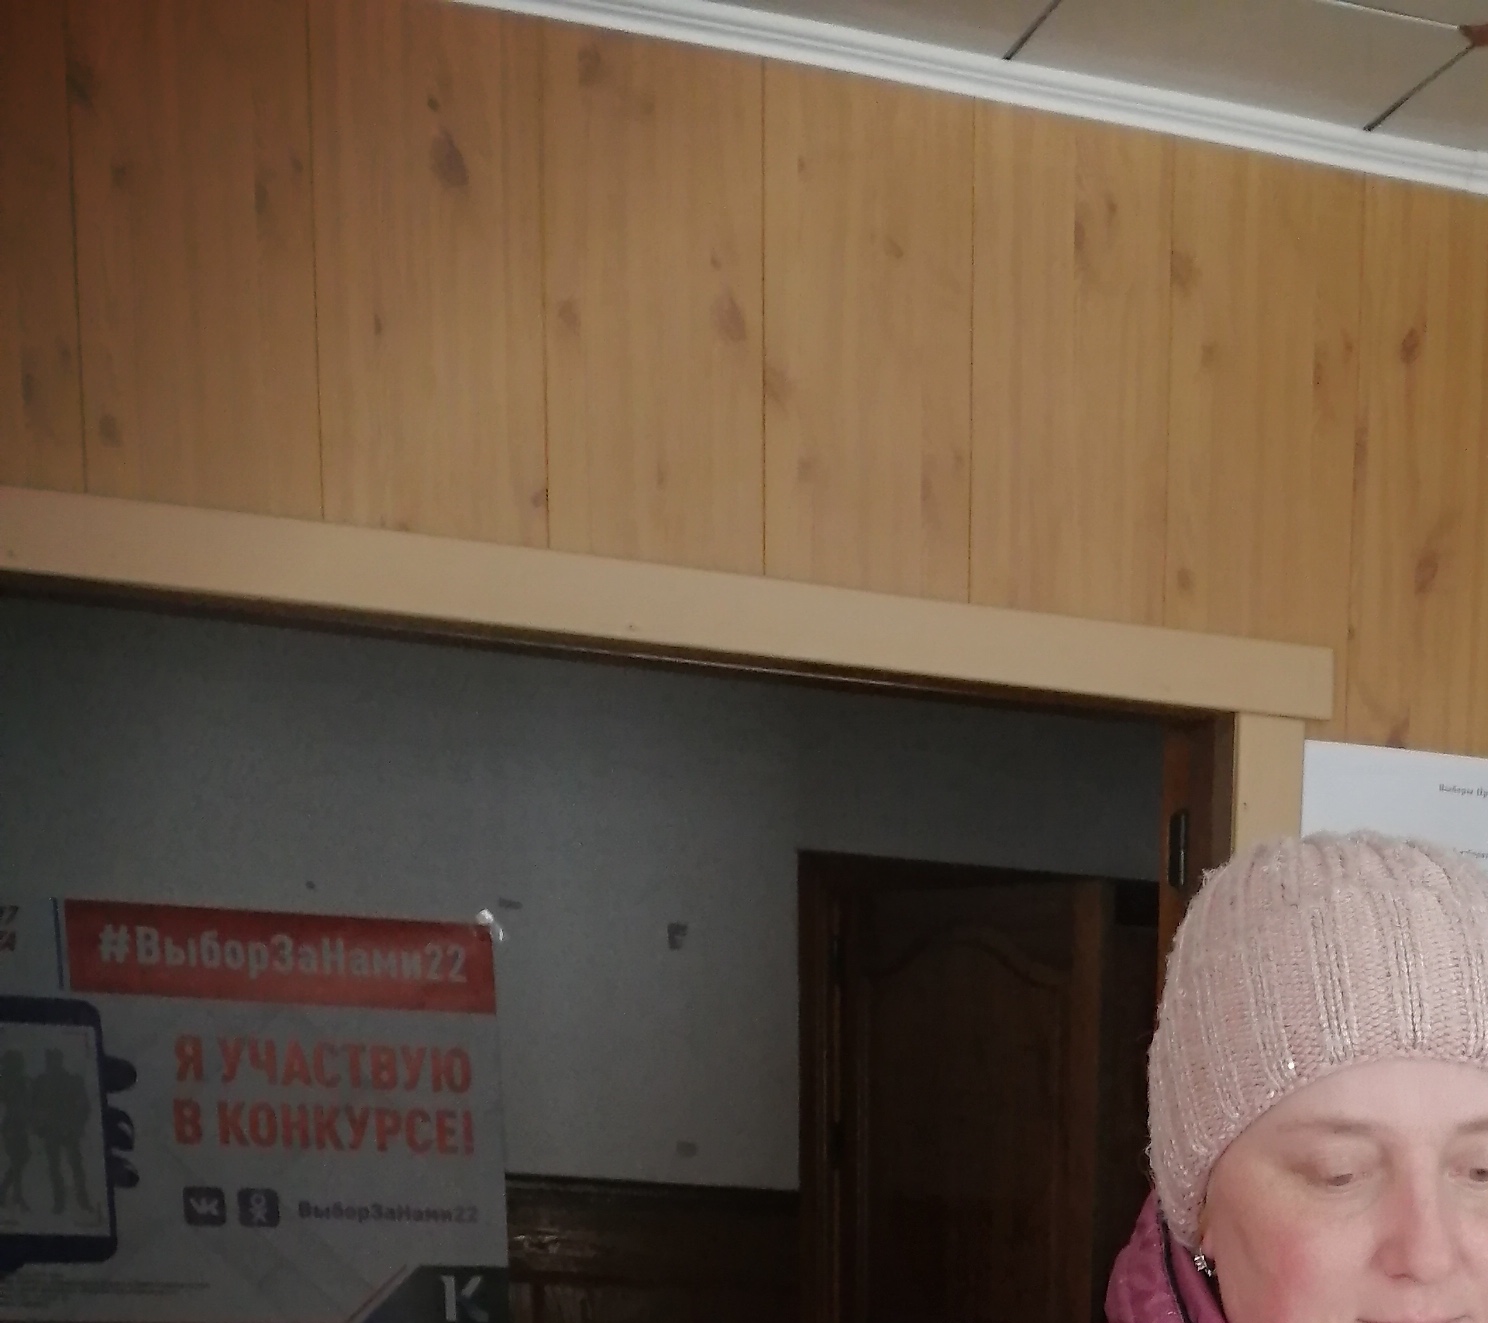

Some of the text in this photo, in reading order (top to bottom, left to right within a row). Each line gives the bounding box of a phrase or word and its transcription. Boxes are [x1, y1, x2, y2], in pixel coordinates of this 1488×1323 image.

[100, 923, 468, 985] #ВыборЗаНами22
[174, 1034, 472, 1094] Я УЧАСТВУЮ
[173, 1101, 476, 1157] В КОНКУРСЕ!
[298, 1200, 479, 1225] ВыборЗаНами22
